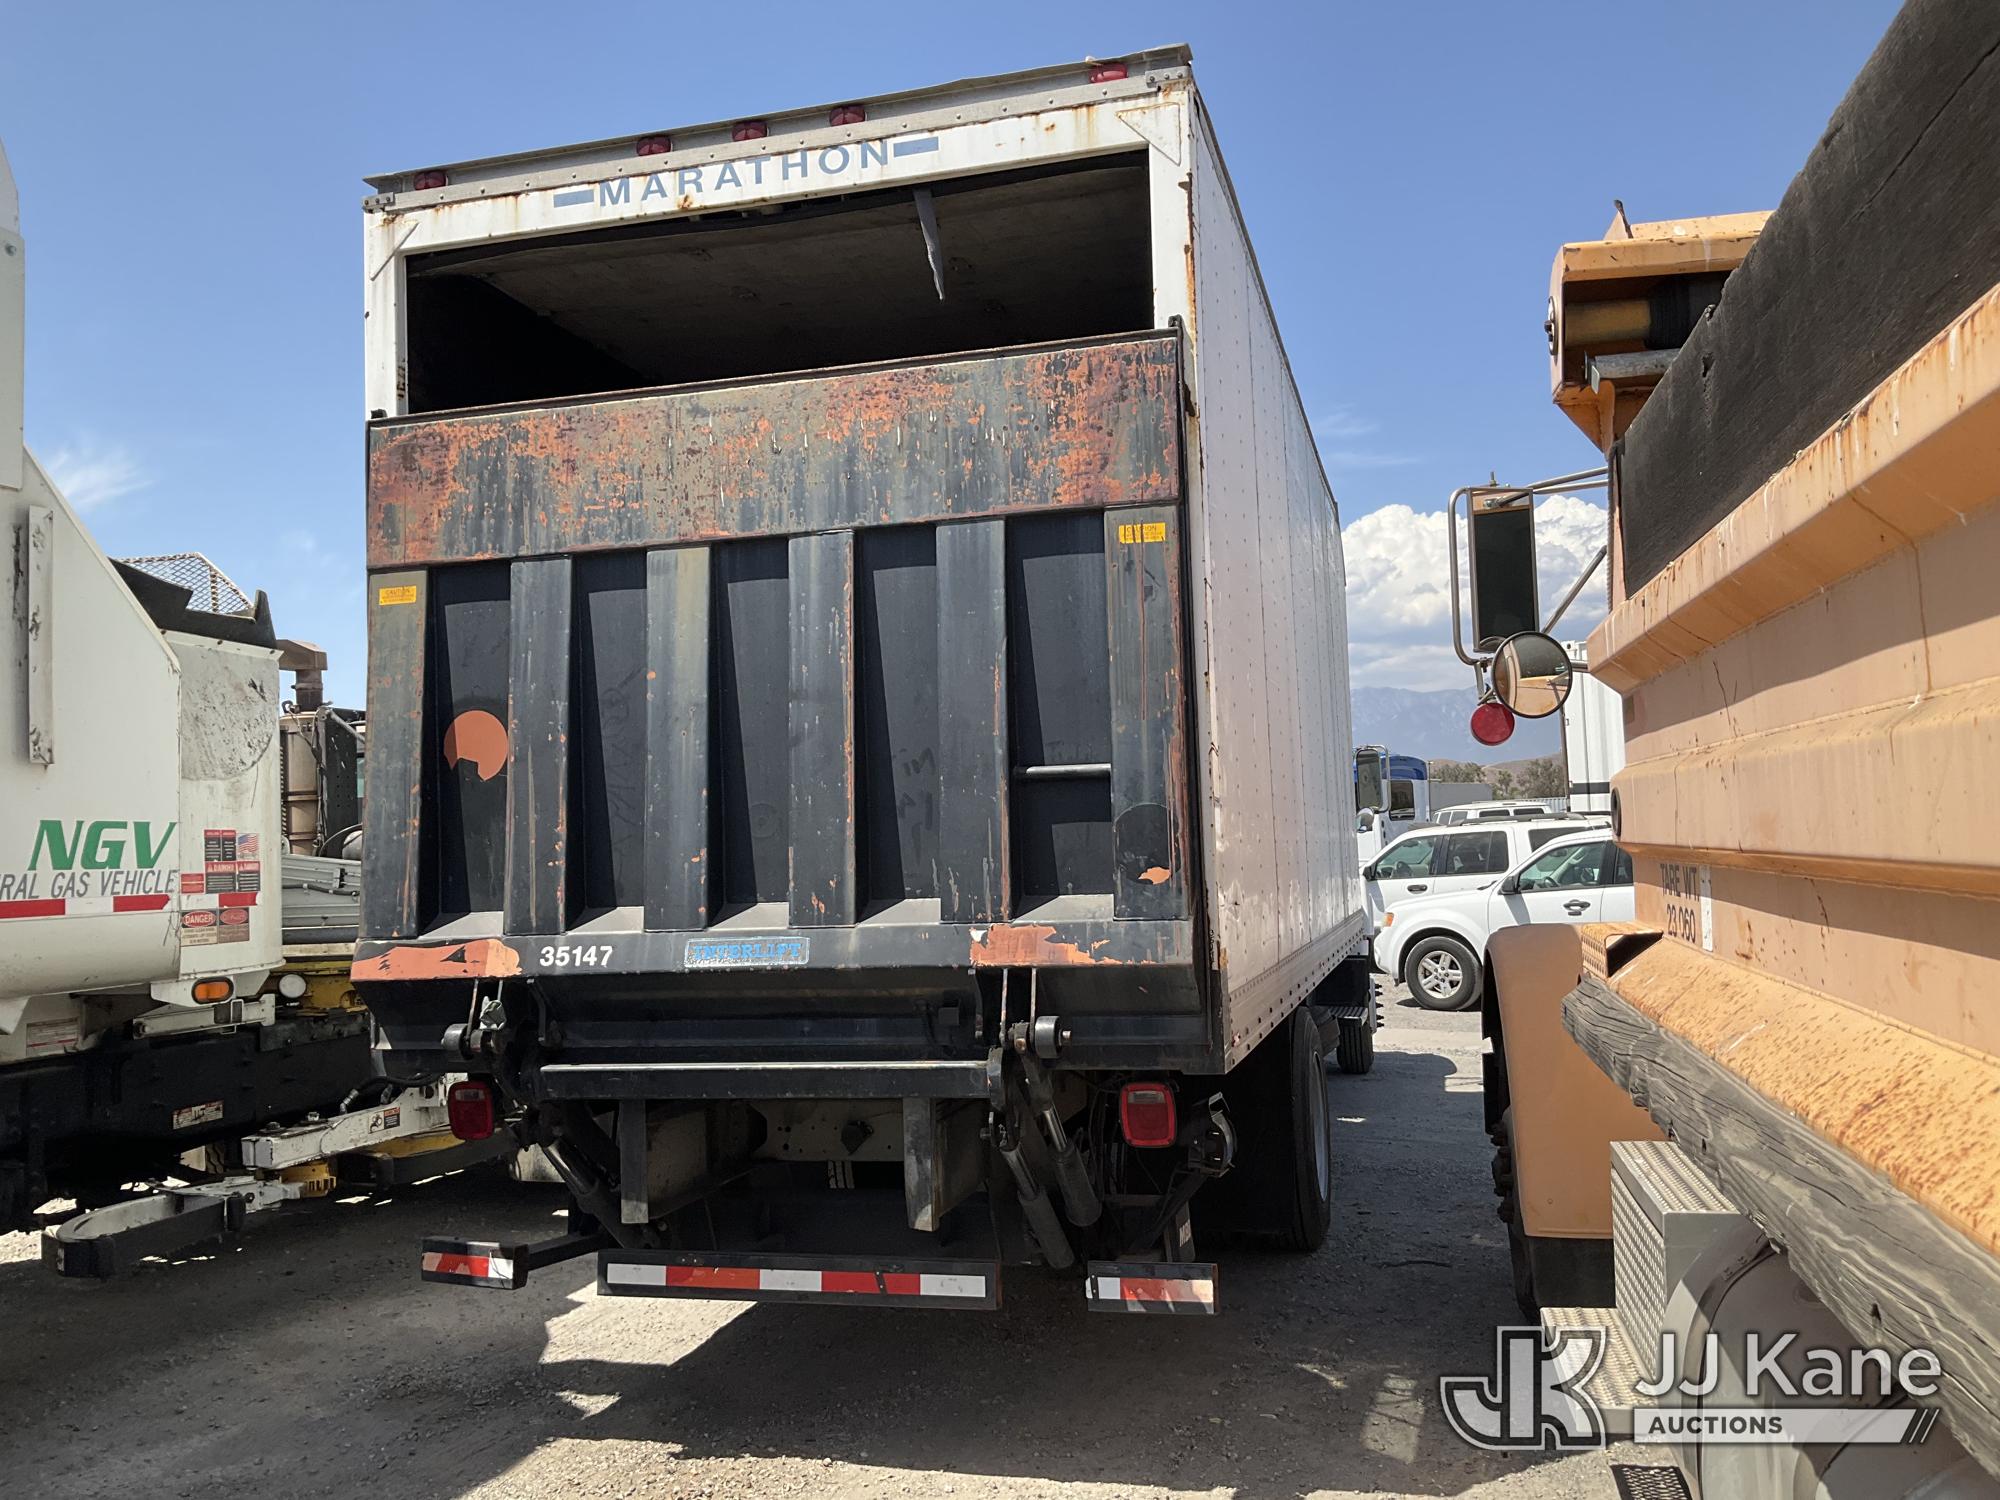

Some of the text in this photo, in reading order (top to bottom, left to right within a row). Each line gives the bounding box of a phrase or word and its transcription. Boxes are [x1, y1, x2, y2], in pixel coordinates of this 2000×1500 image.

[599, 139, 889, 207] MARATHON
[27, 819, 177, 871] NGV
[0, 872, 40, 901] RAL
[51, 870, 91, 899] GAS
[100, 869, 179, 896] VEHICLE
[1660, 863, 1681, 897] TARE
[185, 913, 214, 924] DANGER
[539, 945, 613, 967] 35147
[693, 942, 802, 960] INTERLIFT
